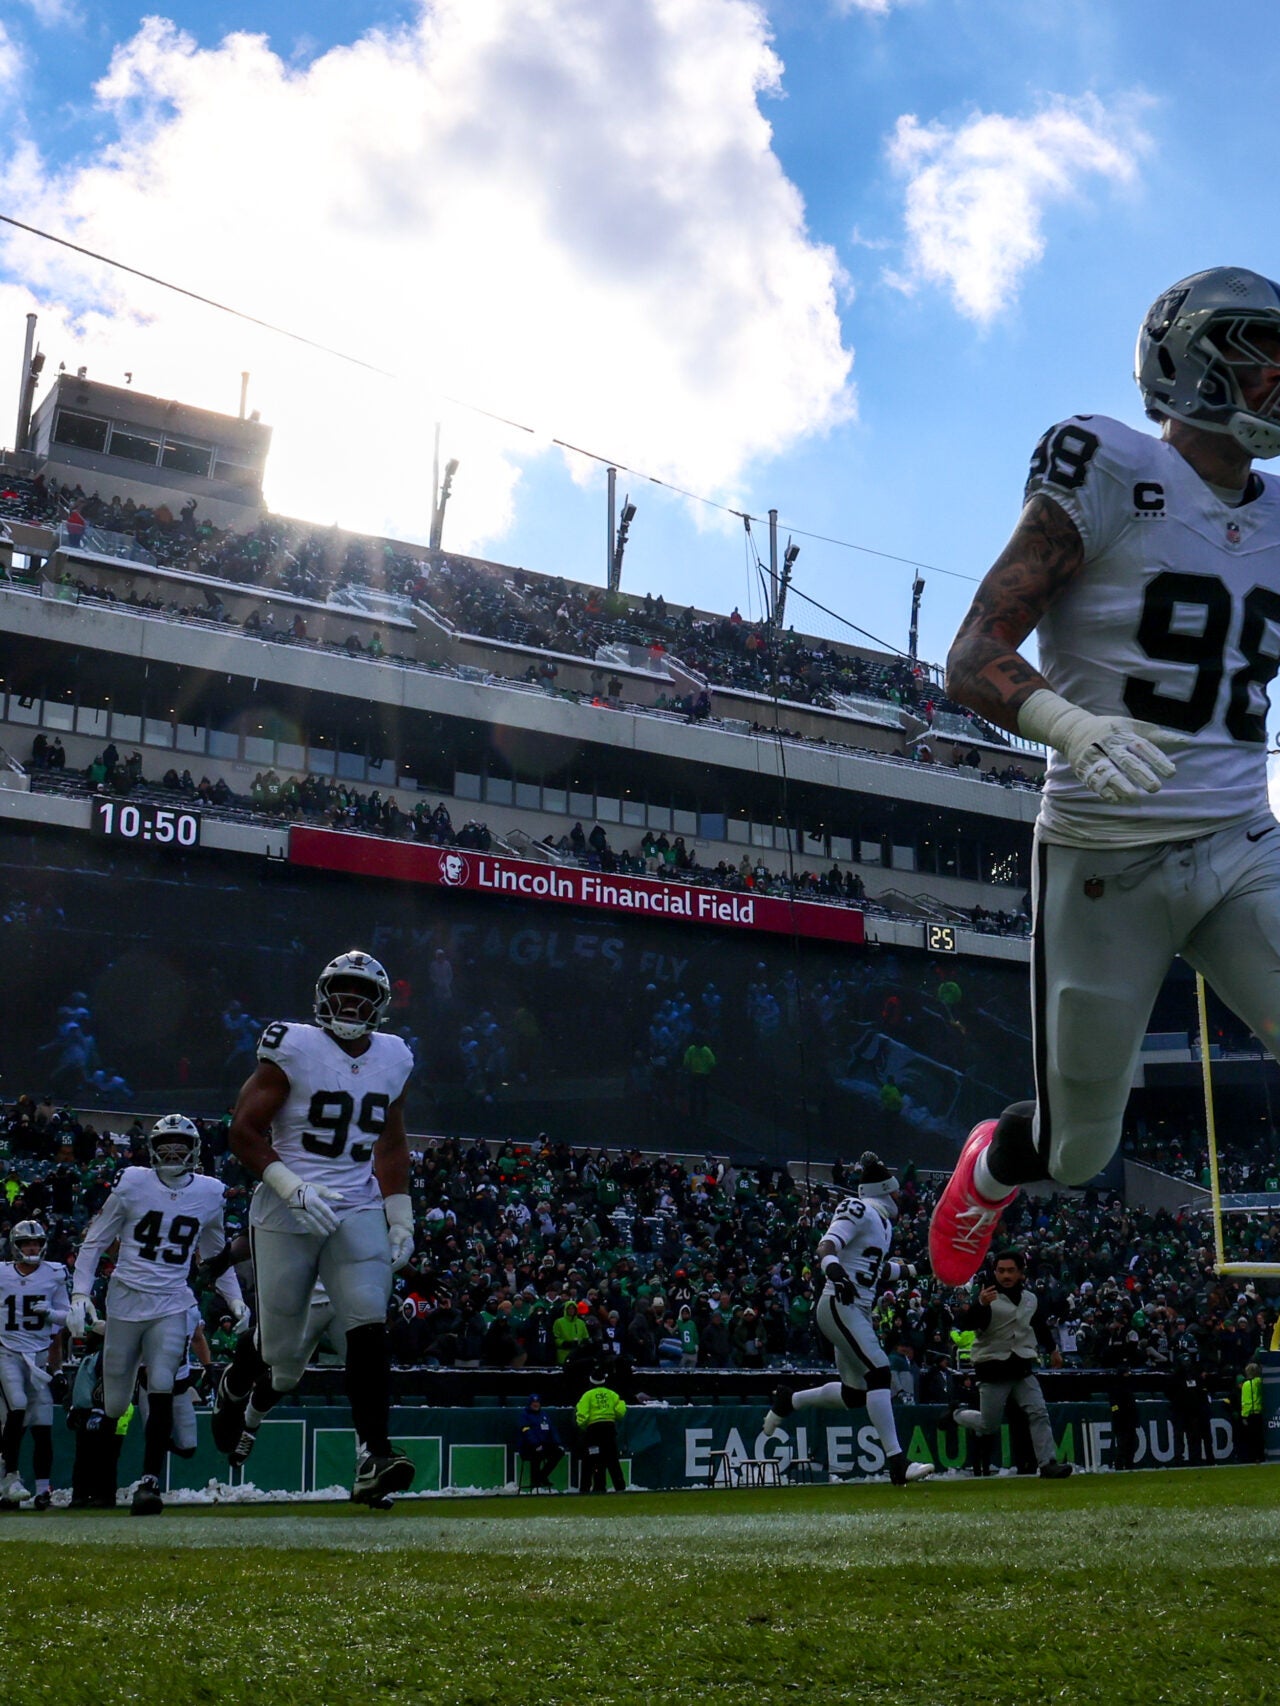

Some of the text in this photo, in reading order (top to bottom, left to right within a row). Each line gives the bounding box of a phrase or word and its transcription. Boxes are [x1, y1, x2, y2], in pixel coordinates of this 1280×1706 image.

[1134, 482, 1164, 509] C
[99, 802, 197, 846] 10:50
[478, 861, 754, 924] Lincoln Financial Field
[930, 926, 954, 950] 25
[258, 1024, 288, 1049] 9
[302, 1090, 390, 1162] 99
[836, 1199, 866, 1219] 33
[134, 1210, 201, 1265] 49
[5, 1295, 47, 1331] 15
[684, 1330, 690, 1343] 6
[685, 1424, 886, 1477] EAGLES
[906, 1422, 1075, 1468] AUIM
